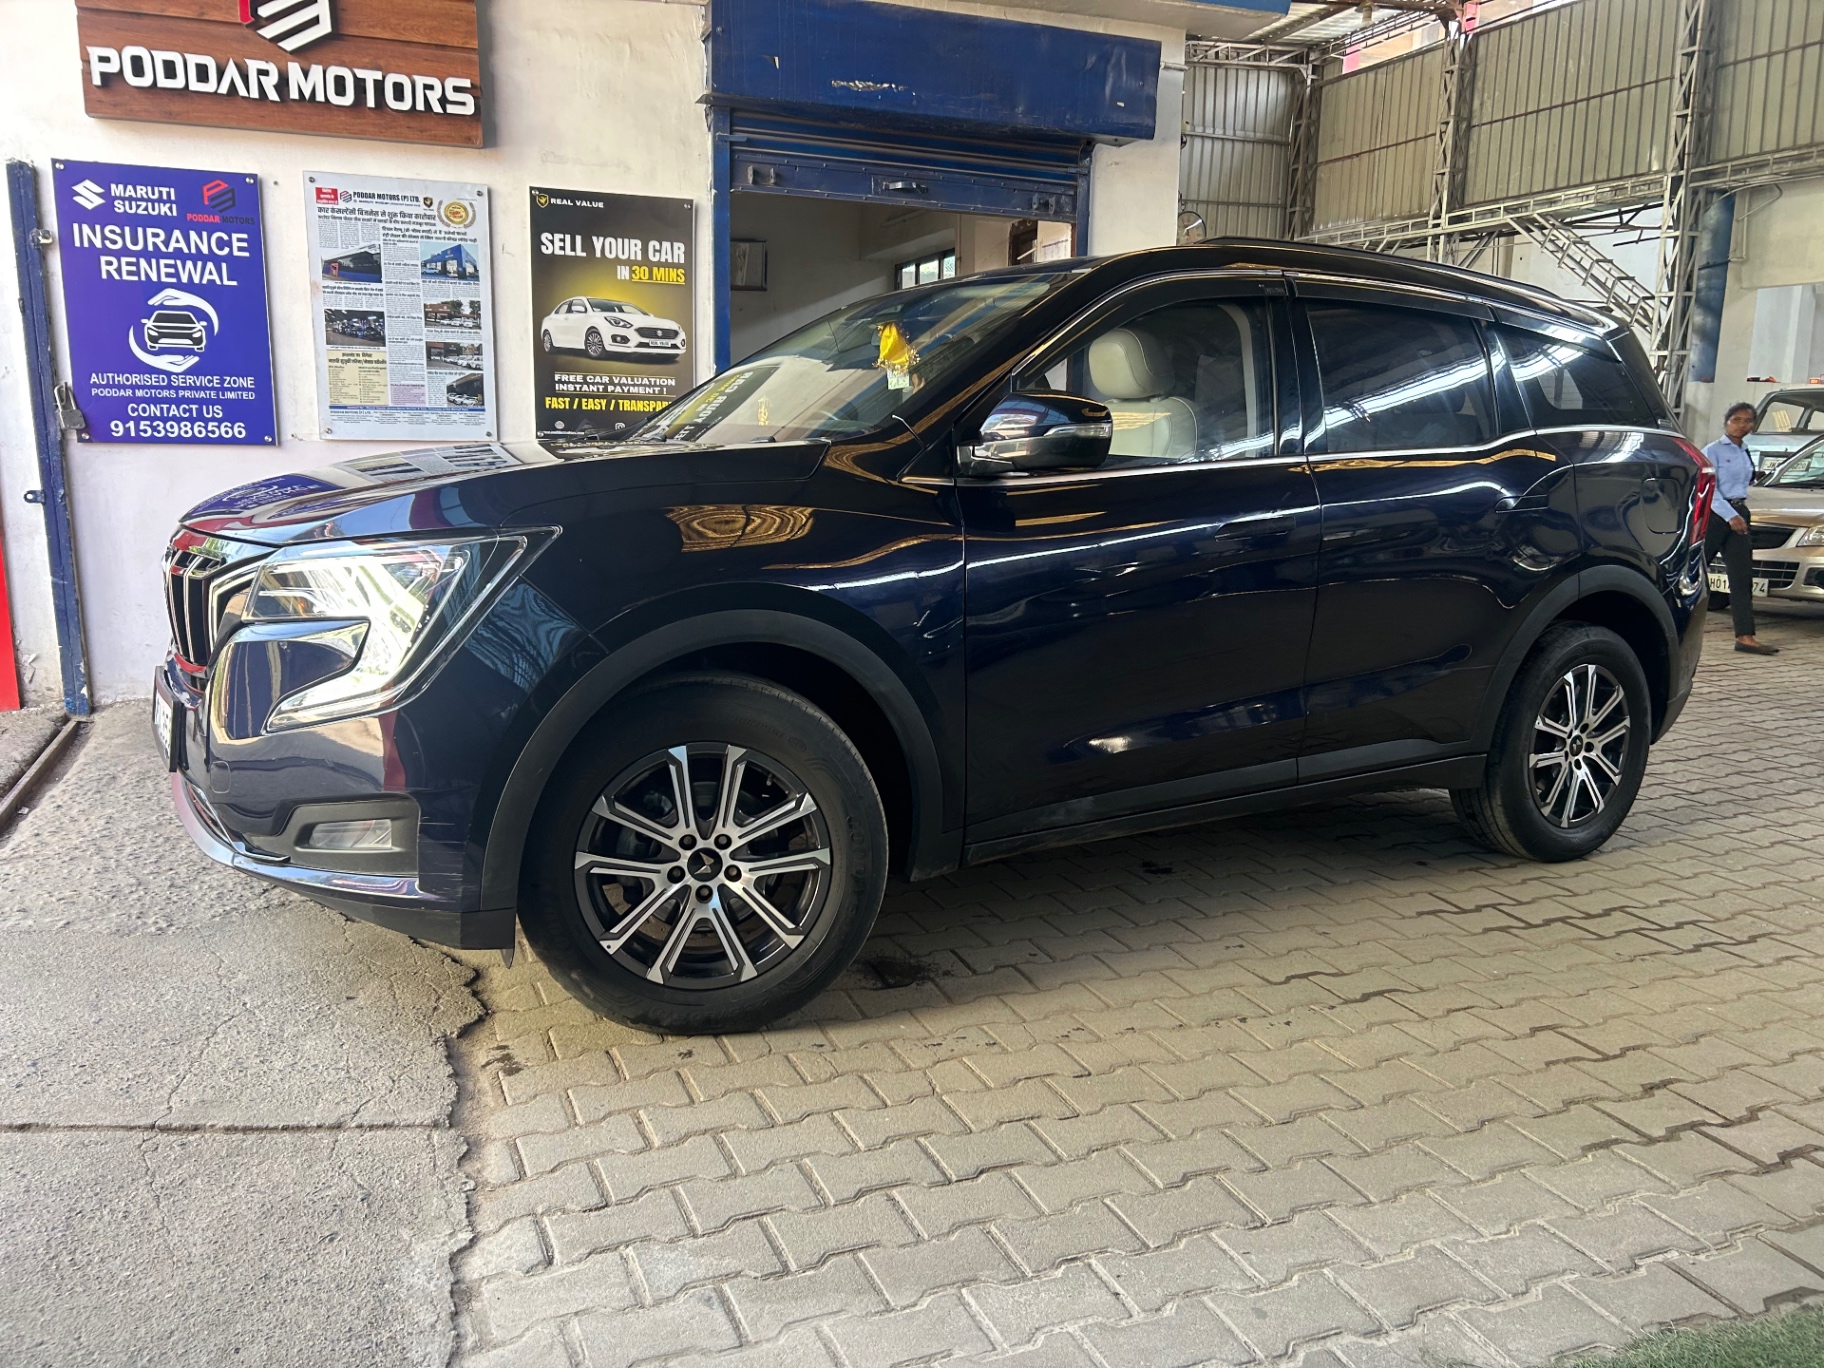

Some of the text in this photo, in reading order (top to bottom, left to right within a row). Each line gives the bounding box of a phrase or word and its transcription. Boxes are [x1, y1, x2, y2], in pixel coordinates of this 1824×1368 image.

[86, 46, 475, 116] PODDAR MOTORS
[110, 183, 176, 200] MARUTI
[353, 191, 376, 200] PODDAR
[377, 193, 400, 202] MOTORS
[114, 199, 177, 217] SUZUKI
[550, 197, 604, 208] REAL VALUE
[186, 213, 256, 225] PODDAR MOTORS
[72, 223, 250, 257] INSURANCE
[540, 232, 685, 264] SELL YOUR CAR
[100, 255, 238, 286] RENEWAL
[617, 265, 686, 283] IN 30 MINS
[90, 372, 255, 389] AUTHORISED SERVICE ZONE
[555, 374, 676, 386] FREE CAR VALUATION
[91, 388, 256, 400] PODDAR MOTORS PRIVATE LIMITED
[555, 384, 604, 392] INSTANT
[607, 385, 660, 395] PAYMENT
[127, 403, 223, 418] CONTACT US
[545, 397, 570, 410] FAST
[581, 398, 607, 411] EASY
[618, 399, 672, 412] TRANSPAR
[110, 420, 246, 438] 9153986566
[1709, 577, 1727, 590] H01
